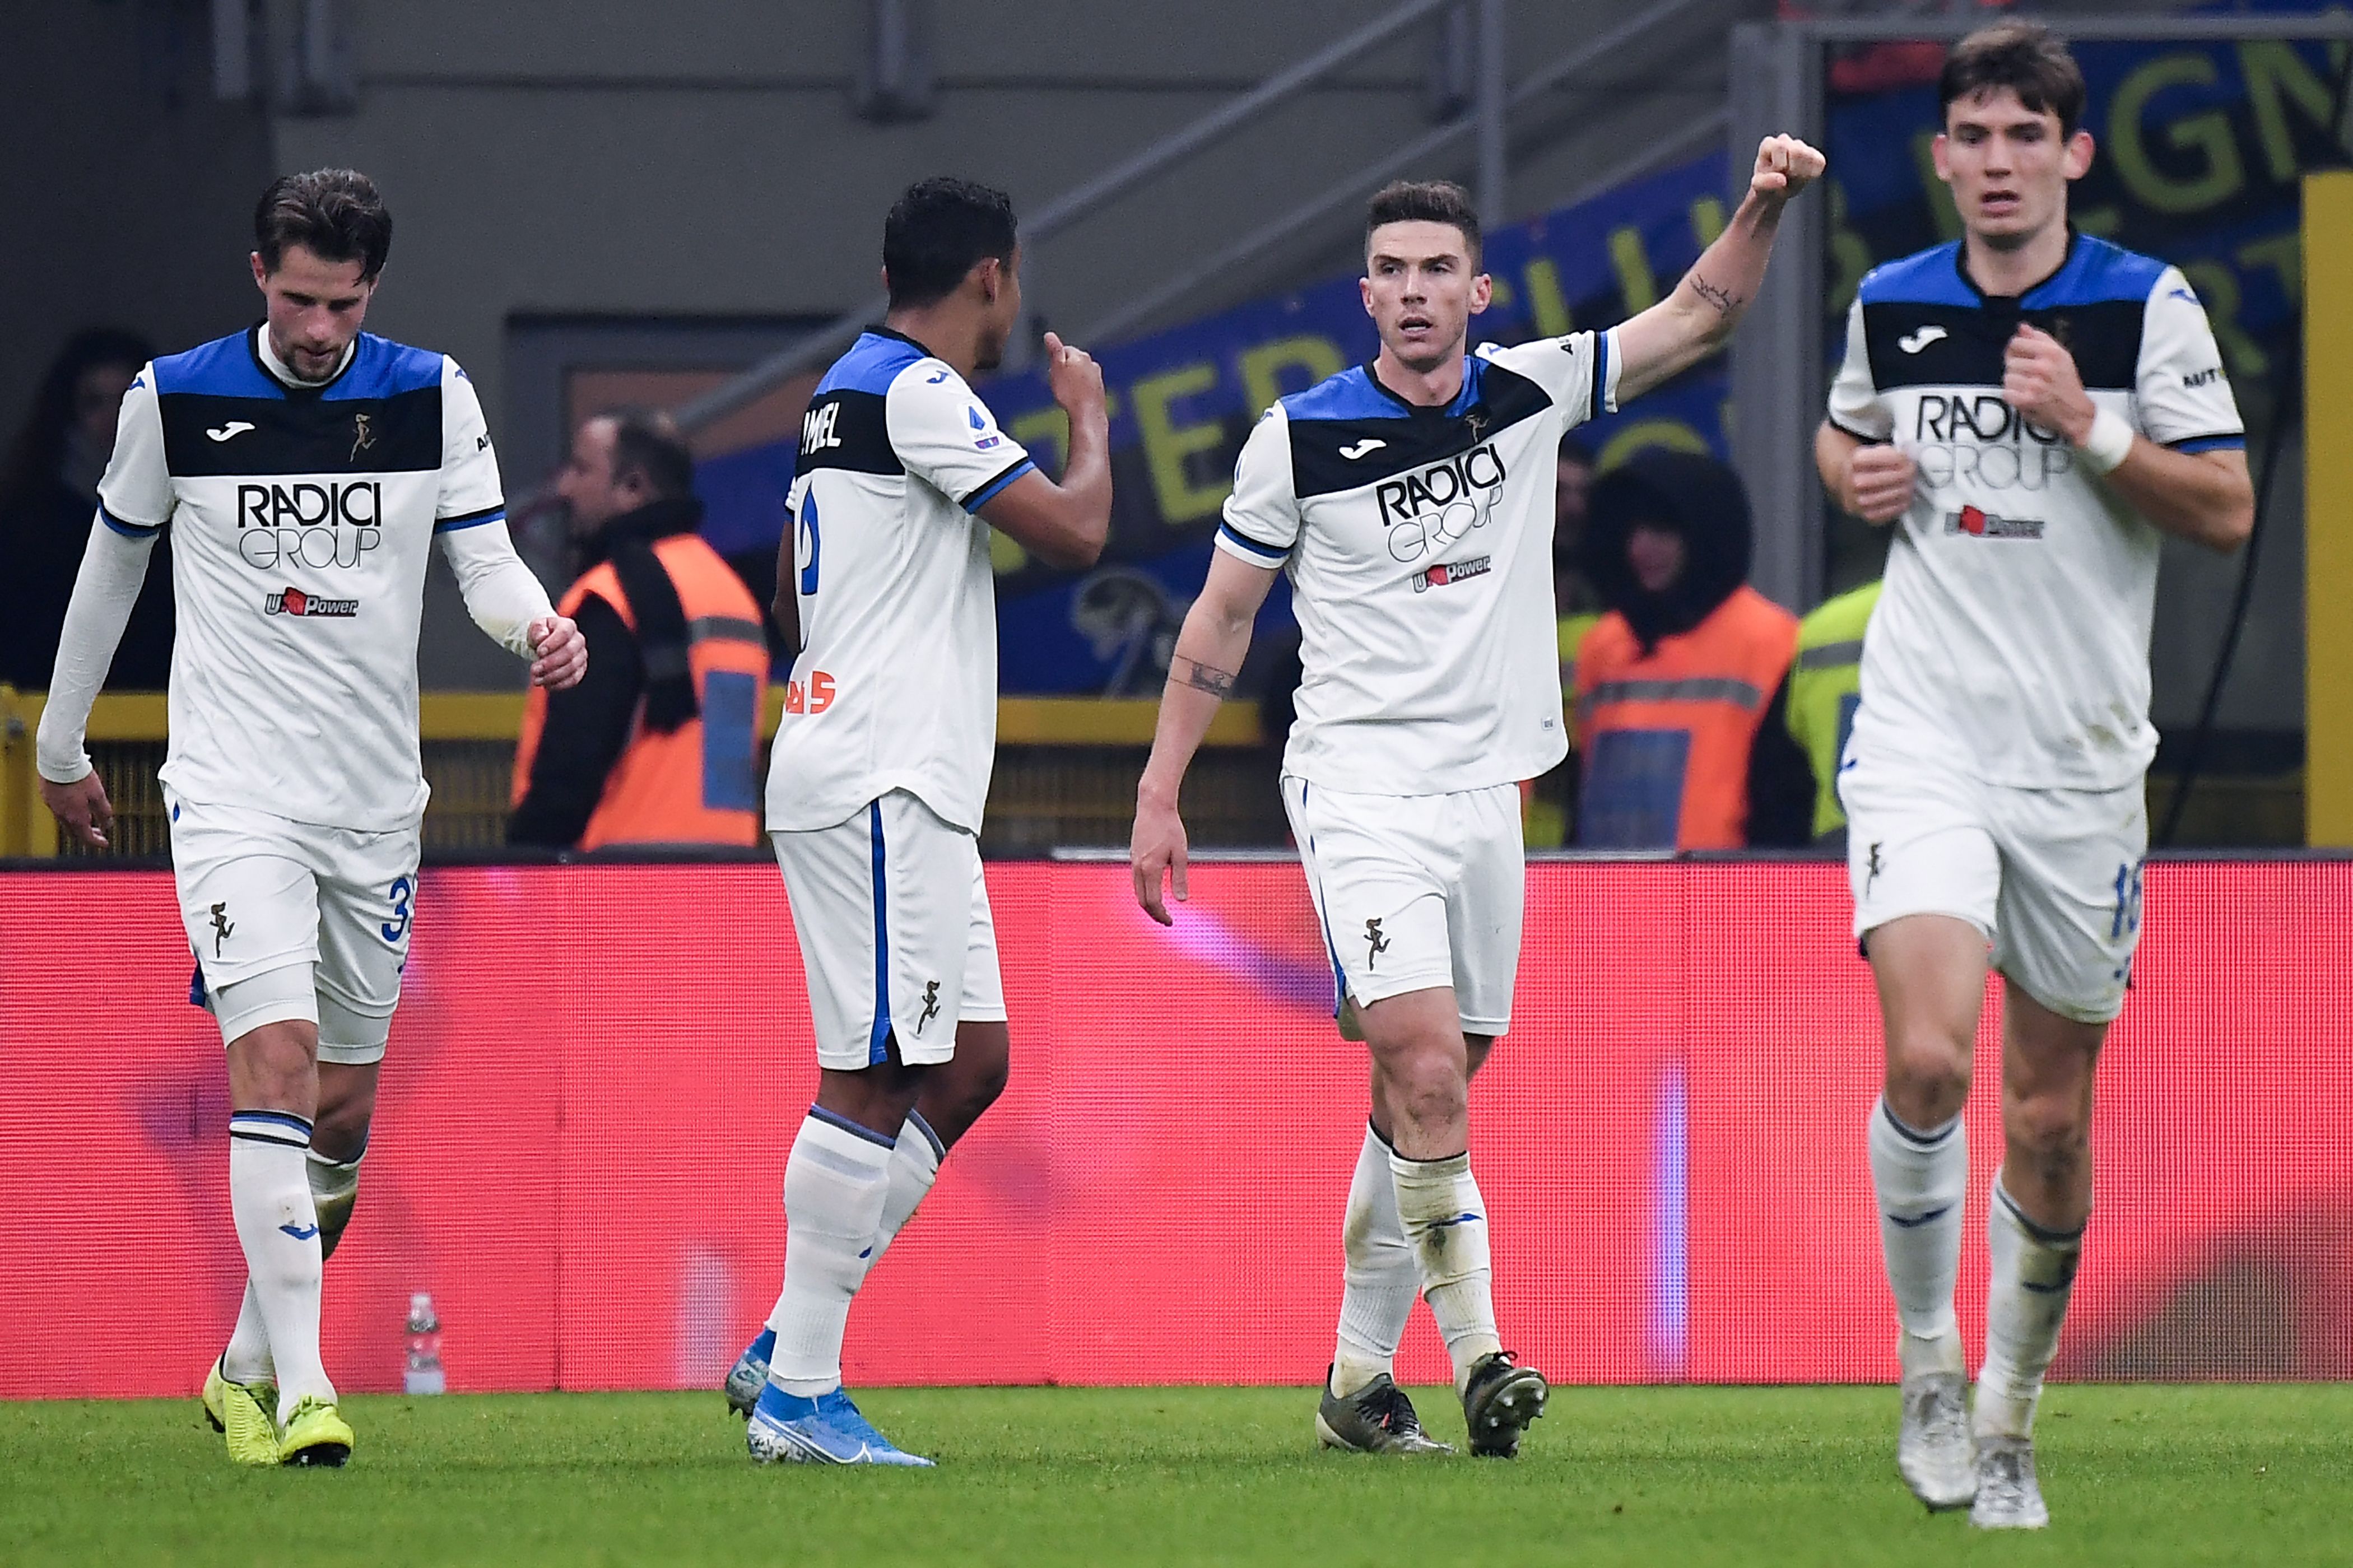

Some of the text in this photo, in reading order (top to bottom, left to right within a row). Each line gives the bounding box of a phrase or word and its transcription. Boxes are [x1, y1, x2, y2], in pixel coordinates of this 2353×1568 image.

[1917, 395, 2067, 444] RADI
[1376, 443, 1506, 527] RADICI
[1917, 445, 2072, 490] GROUP
[238, 481, 381, 528] RADICI
[1388, 484, 1504, 563] GROUP
[239, 527, 381, 570] GROUP
[381, 874, 417, 942] 3
